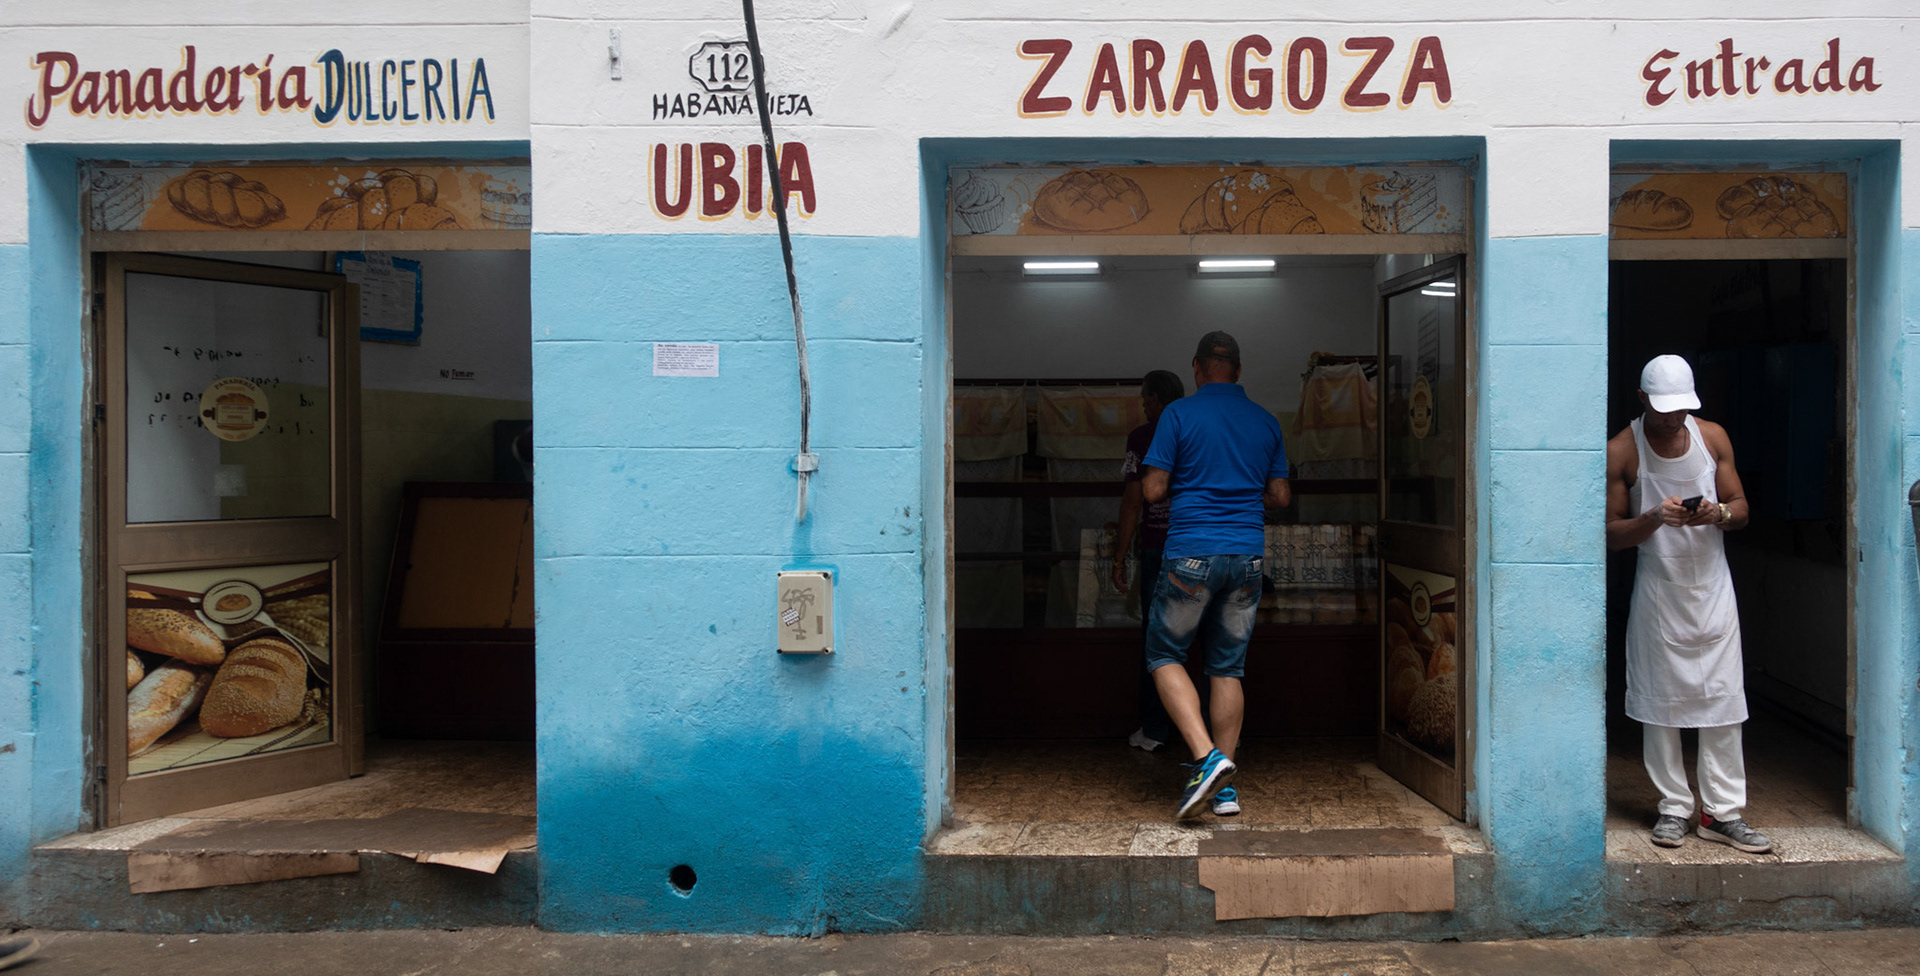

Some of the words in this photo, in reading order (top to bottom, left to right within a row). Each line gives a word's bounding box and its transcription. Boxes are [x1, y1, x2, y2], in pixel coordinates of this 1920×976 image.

[27, 45, 312, 128] Panadería
[314, 49, 496, 125] DULCERIA
[707, 54, 749, 82] 112
[1020, 34, 1452, 116] ZARAGOZA
[1641, 37, 1882, 107] Entrada
[653, 93, 754, 120] HABANA
[766, 93, 813, 117] IEJA
[652, 142, 816, 219] UBIA
